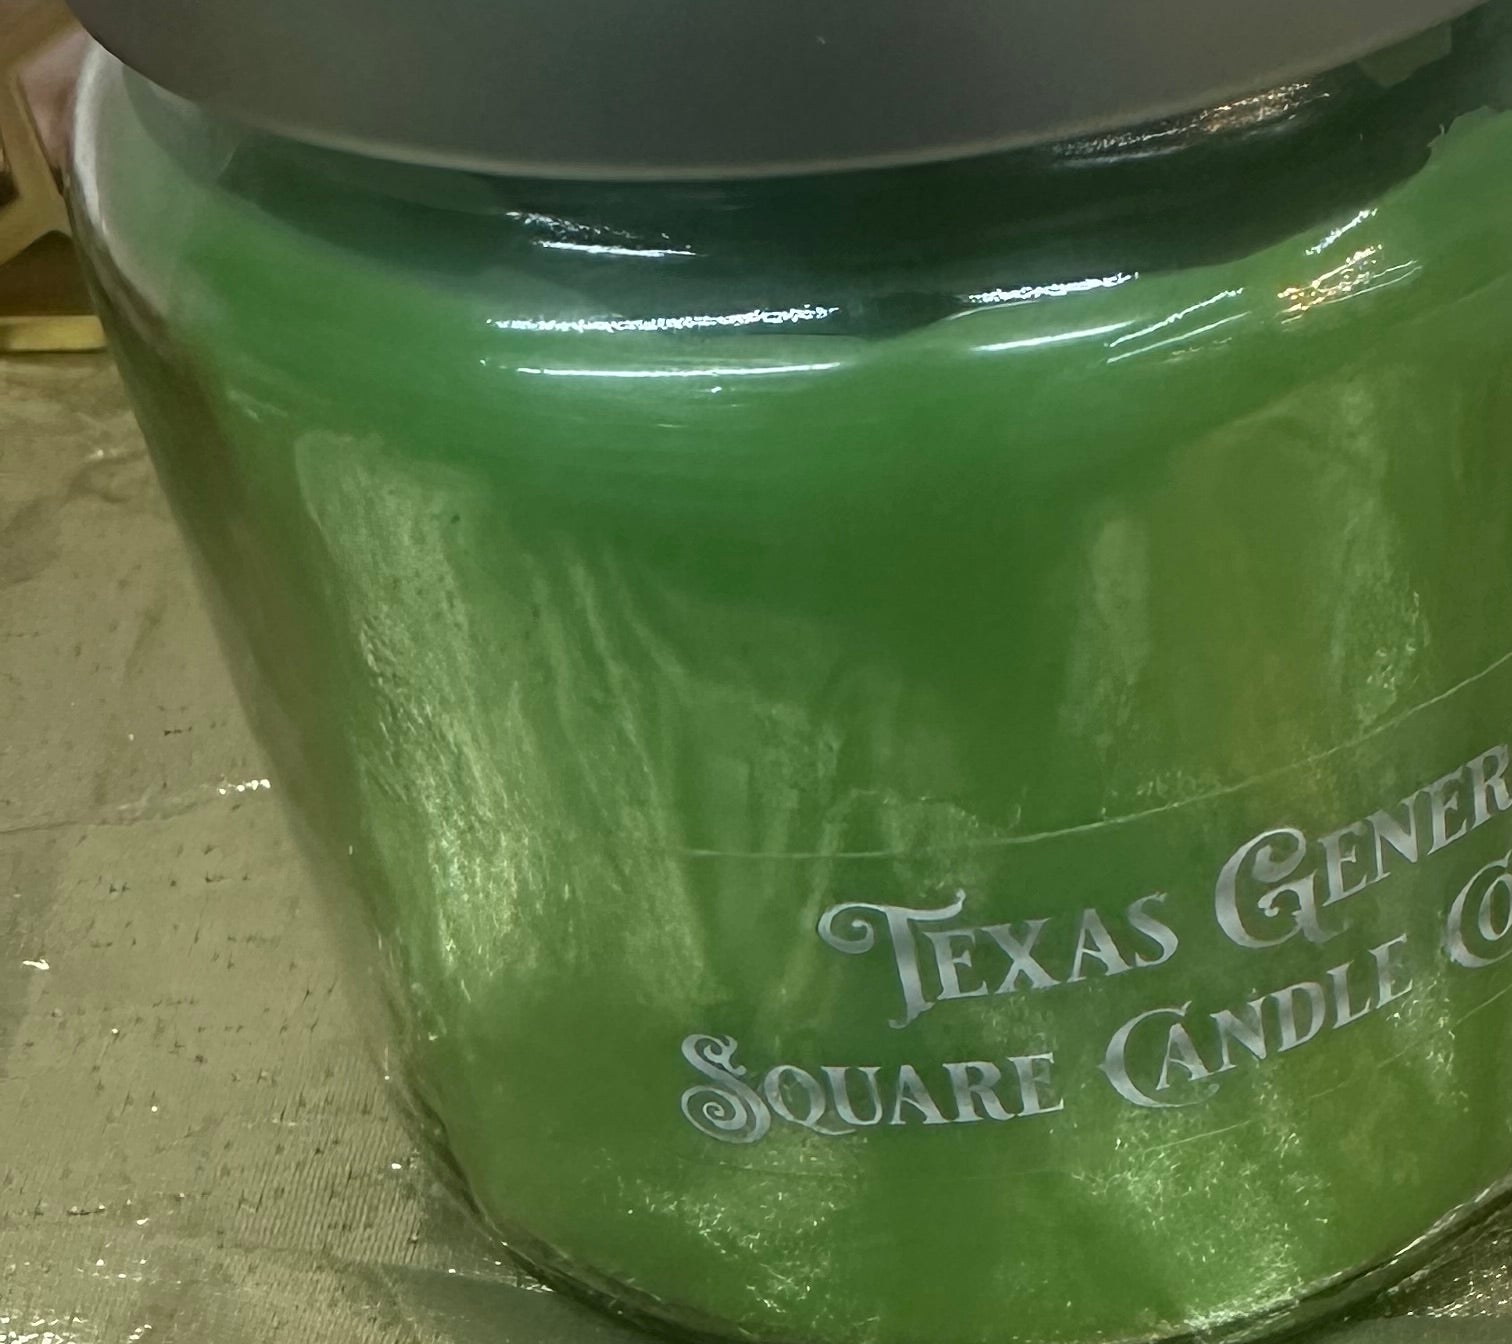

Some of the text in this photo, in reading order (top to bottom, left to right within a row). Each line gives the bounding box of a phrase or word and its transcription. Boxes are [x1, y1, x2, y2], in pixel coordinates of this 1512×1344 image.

[680, 1033, 1064, 1144] SQUARE
[1099, 933, 1414, 1109] CANDLE
[817, 888, 1179, 1029] TEXAS
